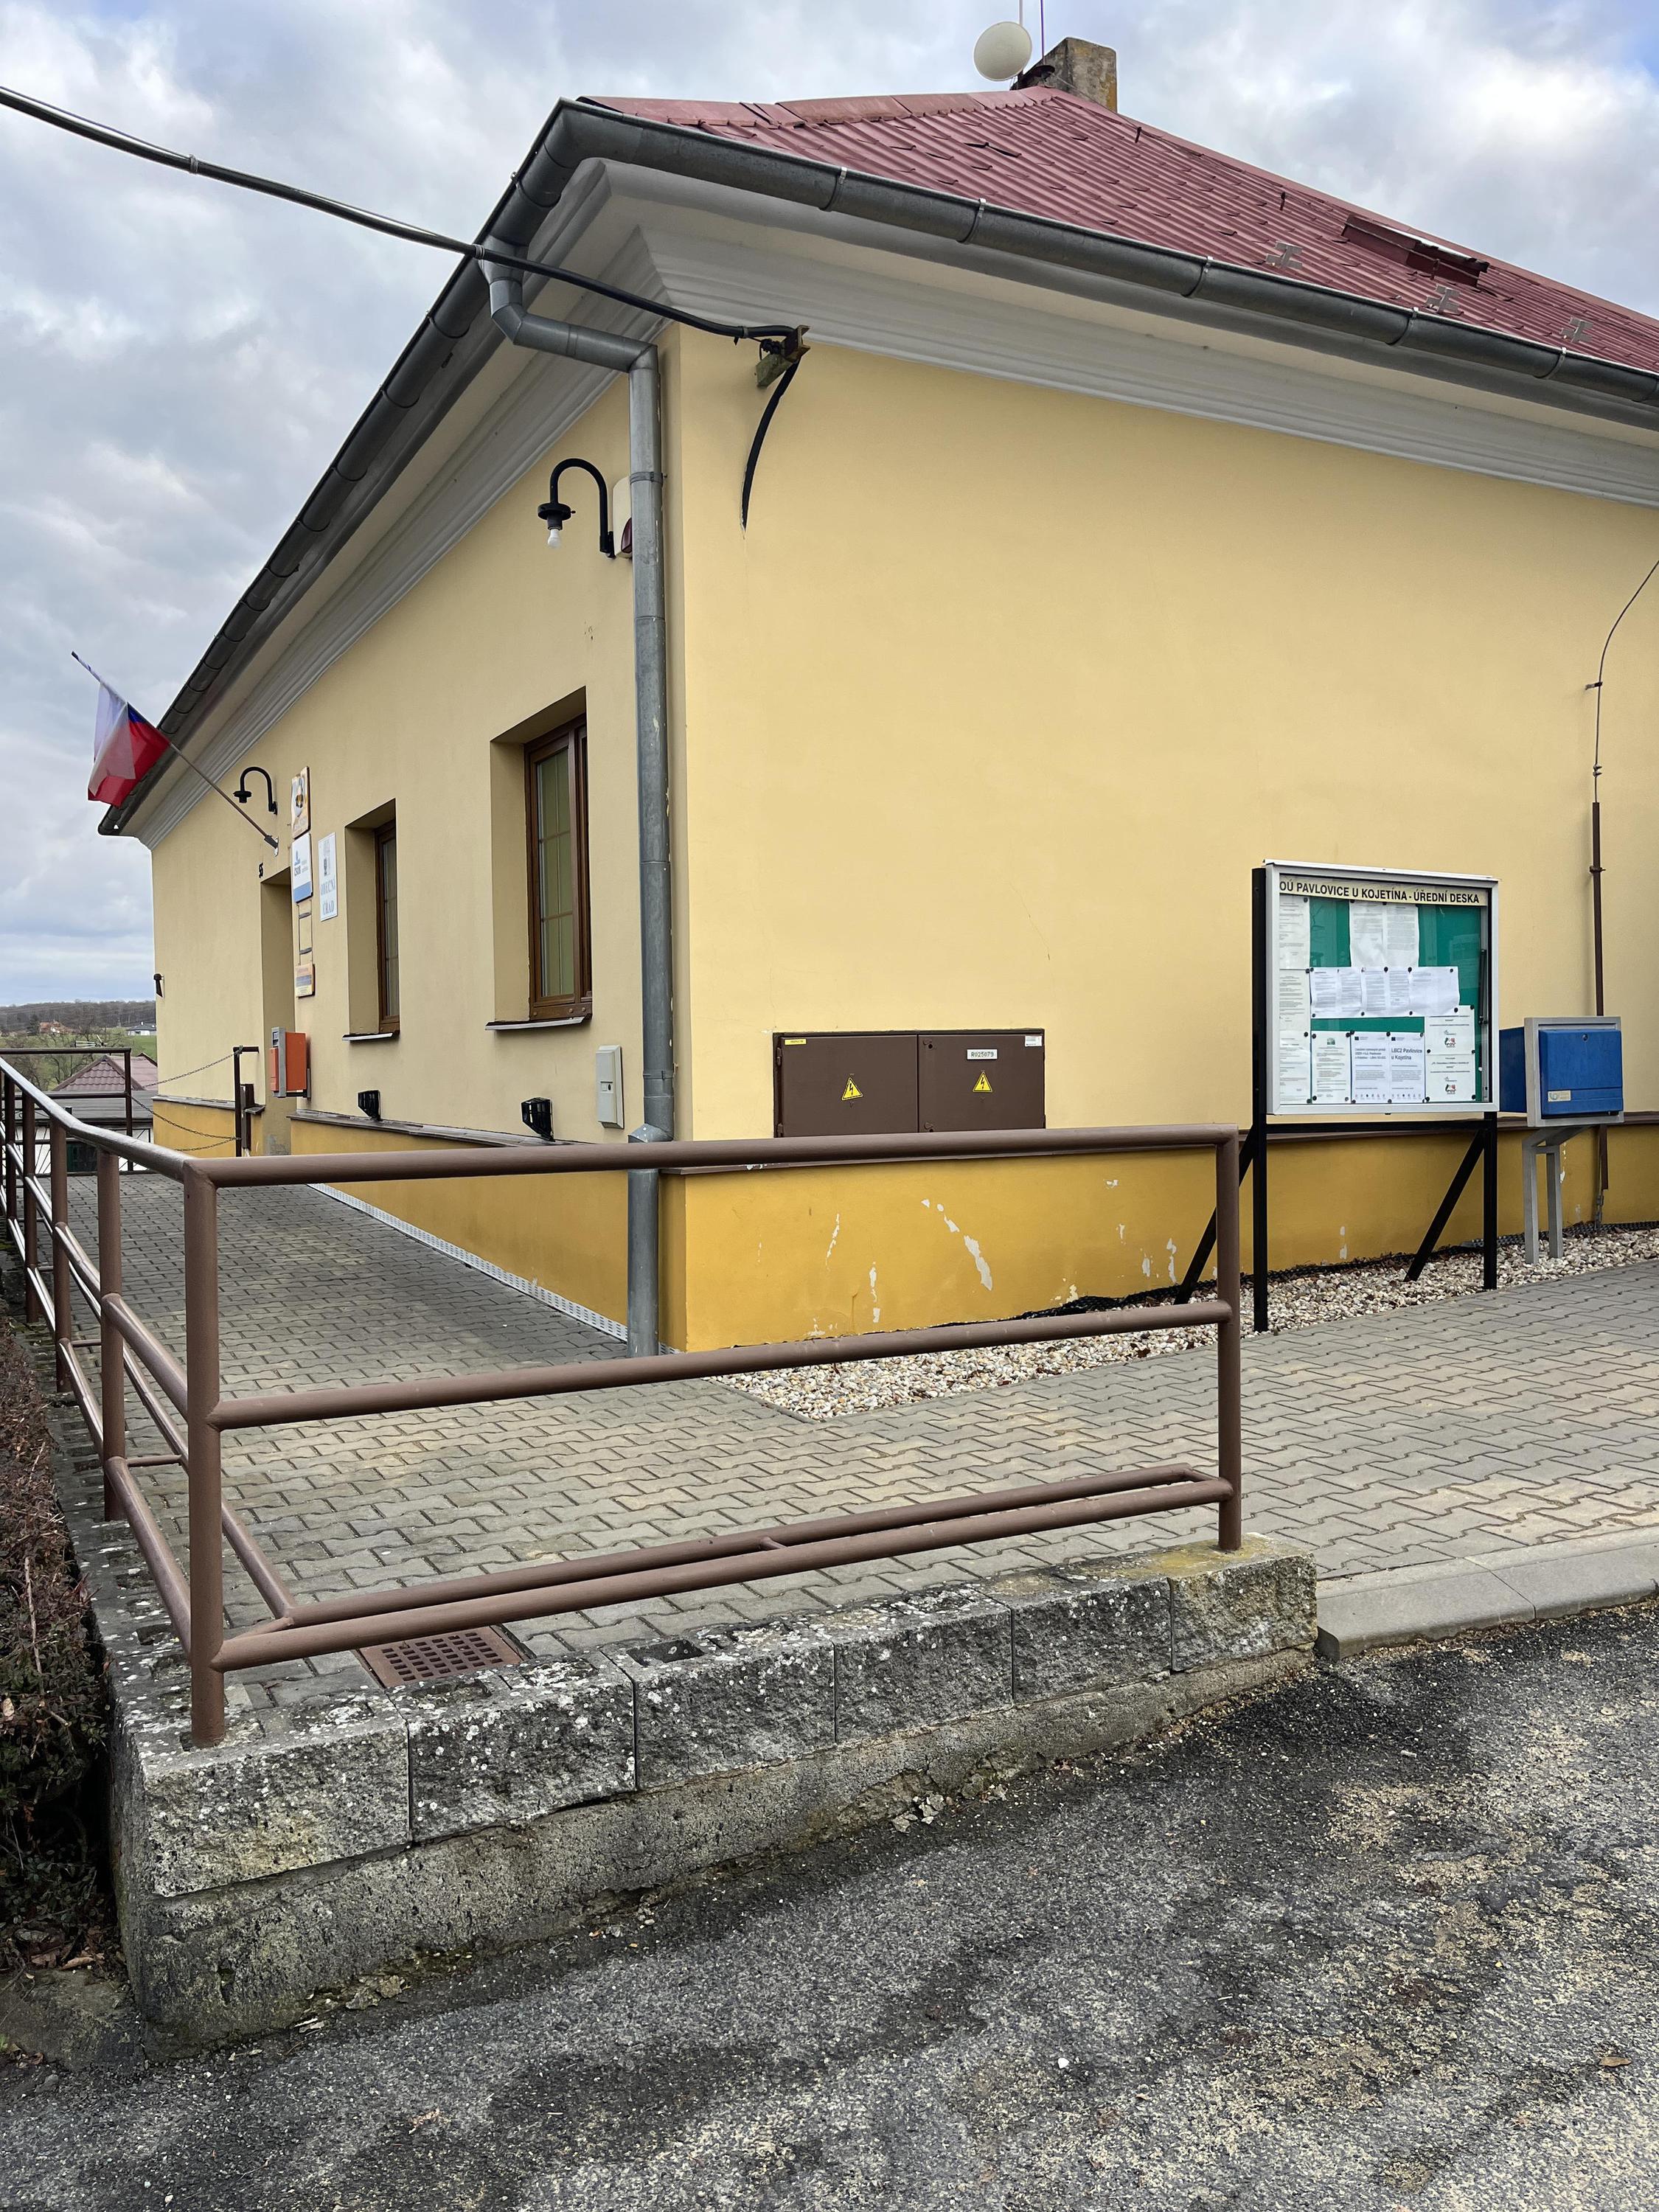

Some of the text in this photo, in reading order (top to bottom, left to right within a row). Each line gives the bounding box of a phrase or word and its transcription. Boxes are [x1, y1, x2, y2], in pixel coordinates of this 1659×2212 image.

[1279, 878, 1293, 891] OÚ
[1296, 883, 1349, 897] PAVLOVICE
[1352, 888, 1358, 897] U
[1362, 887, 1408, 900] KOJETÍNA
[1413, 888, 1447, 902] ÚŘEDNÍ
[1450, 893, 1480, 903] DESKA
